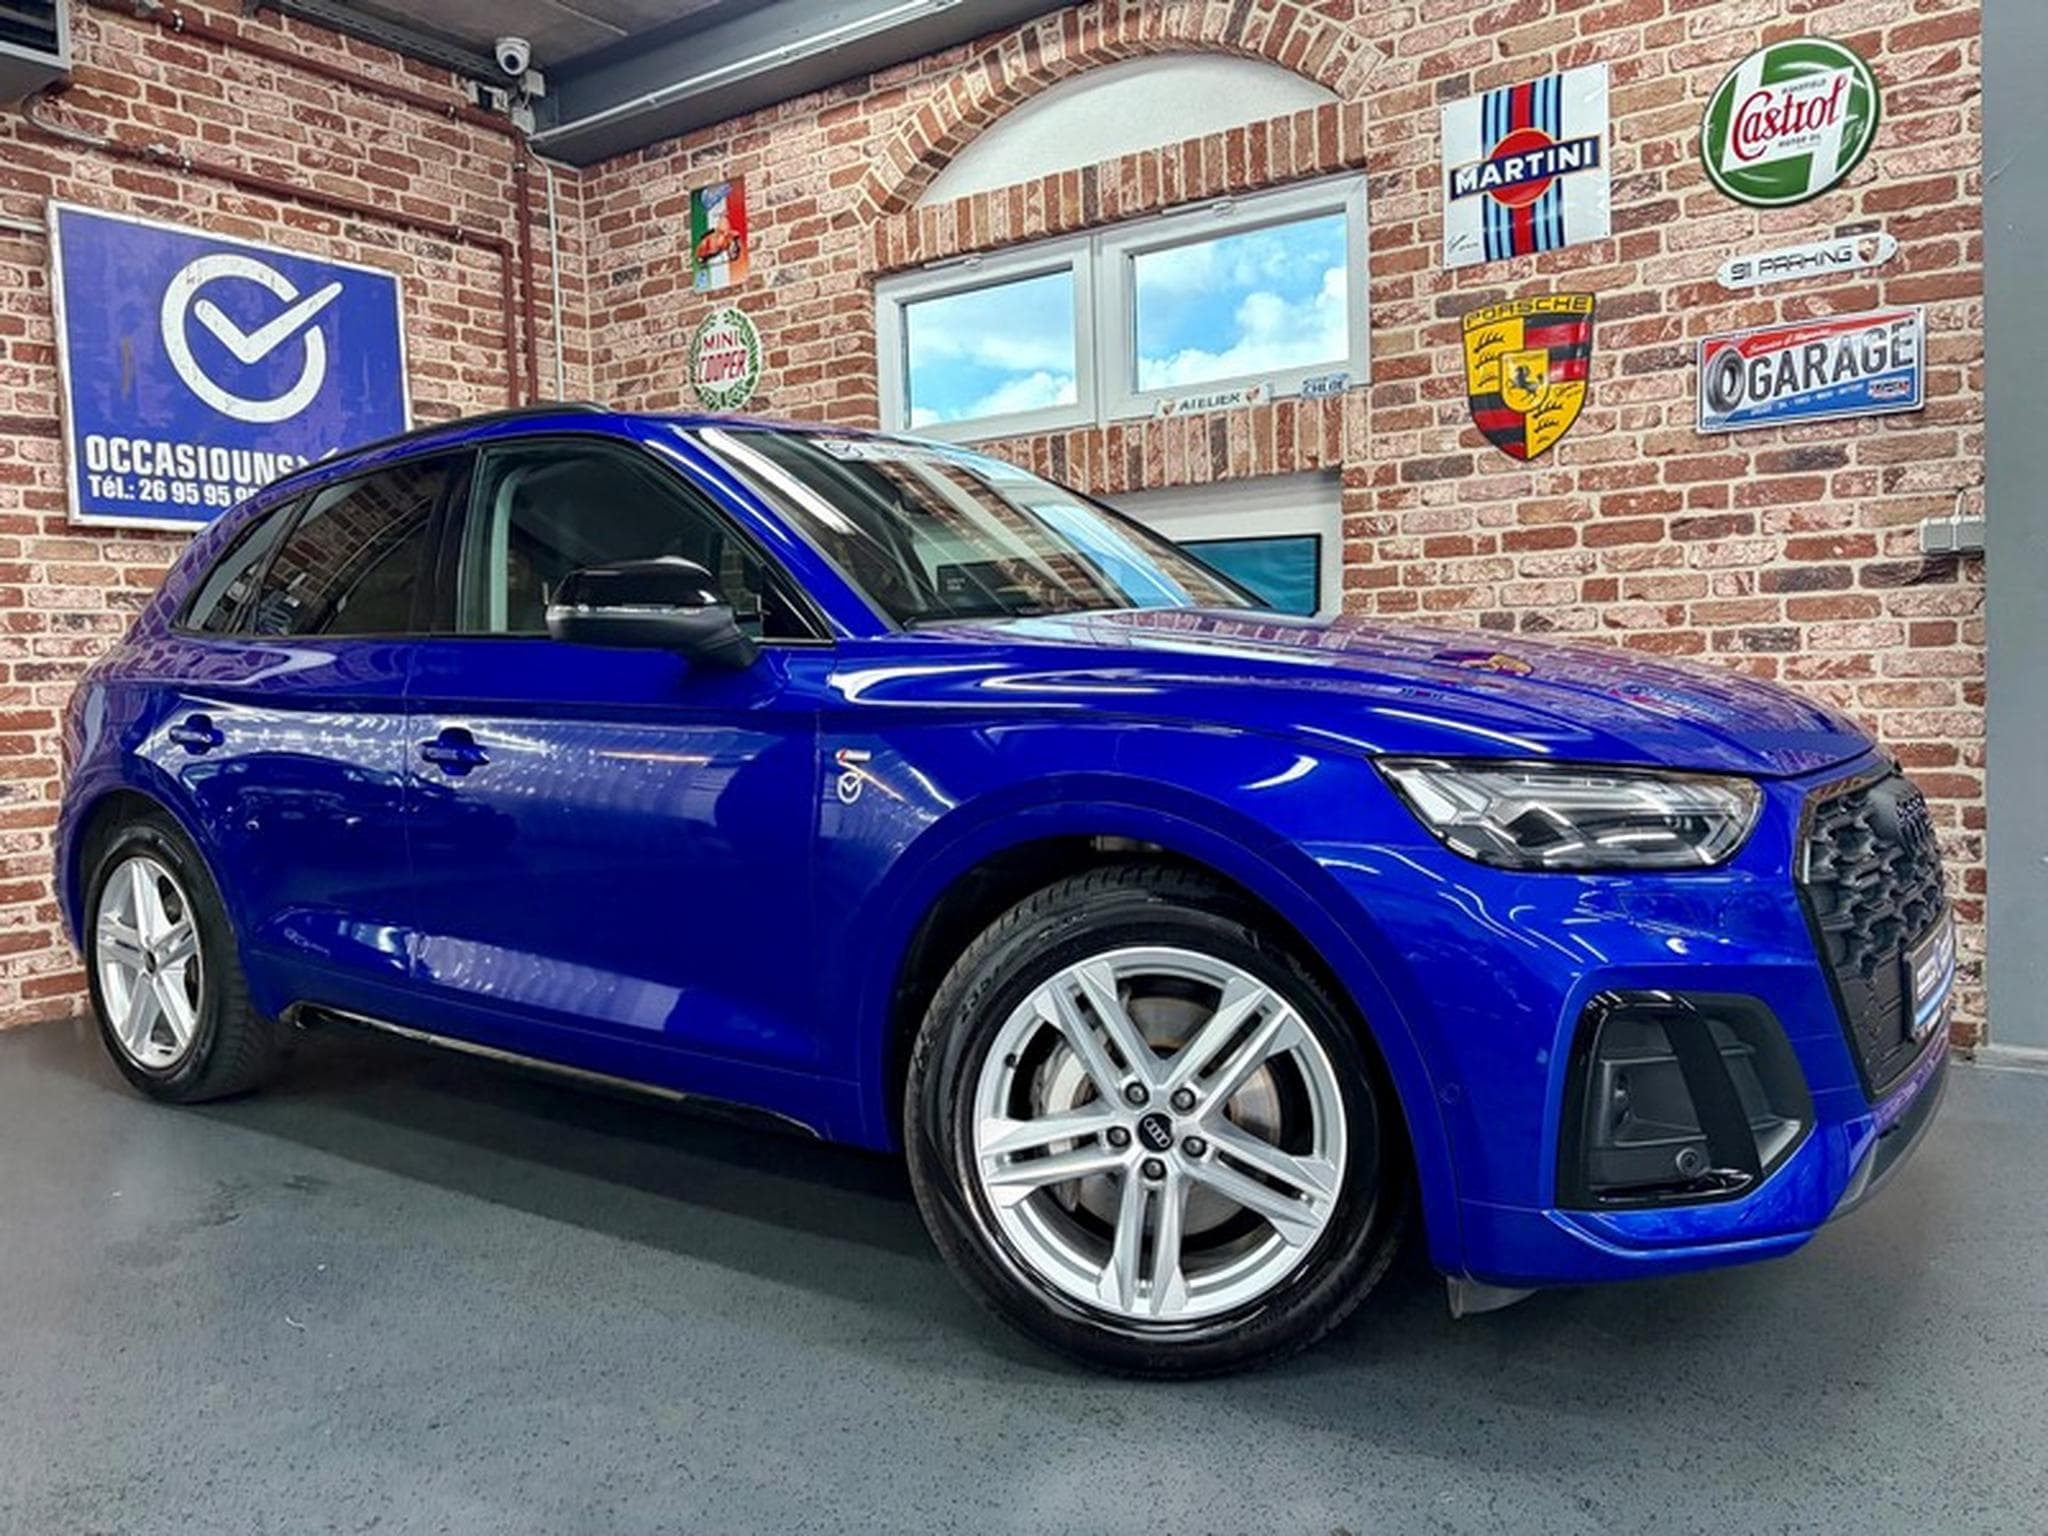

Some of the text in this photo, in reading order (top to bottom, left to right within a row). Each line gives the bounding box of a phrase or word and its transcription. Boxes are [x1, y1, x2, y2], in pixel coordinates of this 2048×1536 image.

[1732, 75, 1847, 161] Castrol
[1455, 141, 1593, 194] MARTINI
[1466, 296, 1588, 328] PORSCHE
[704, 331, 738, 351] MINI
[699, 350, 746, 383] COOPER
[1750, 319, 1914, 402] GARAGE
[88, 474, 135, 500] Tél.:
[139, 480, 166, 502] 26
[172, 481, 199, 506] 95
[204, 485, 231, 508] 95
